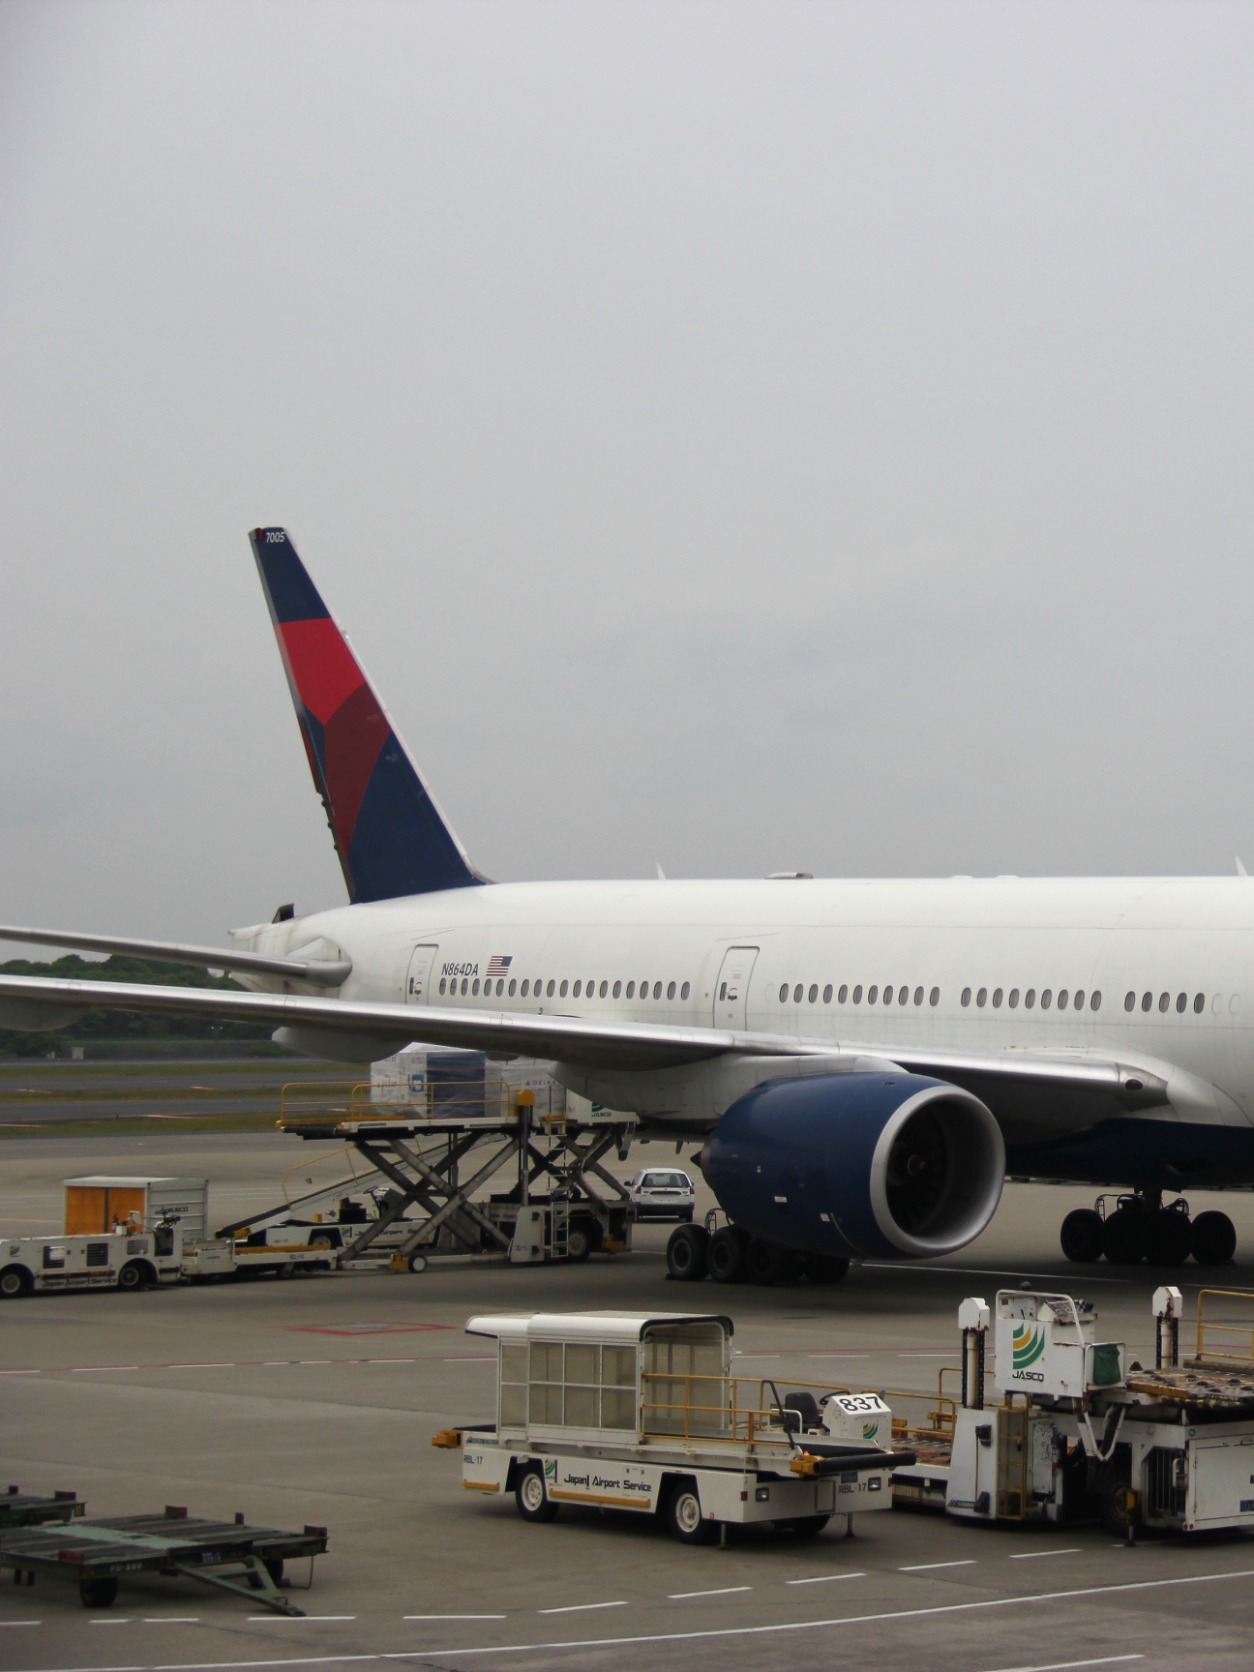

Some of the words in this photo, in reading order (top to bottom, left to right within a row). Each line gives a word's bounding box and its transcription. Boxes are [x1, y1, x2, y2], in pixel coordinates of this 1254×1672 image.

[266, 531, 285, 543] 7005
[441, 963, 479, 976] N864DA
[1012, 1370, 1045, 1382] JASCO
[839, 1396, 882, 1412] 837
[564, 1474, 587, 1485] Japan
[592, 1475, 620, 1489] Airport
[623, 1480, 652, 1492] Service
[839, 1482, 867, 1494] RBL-17
